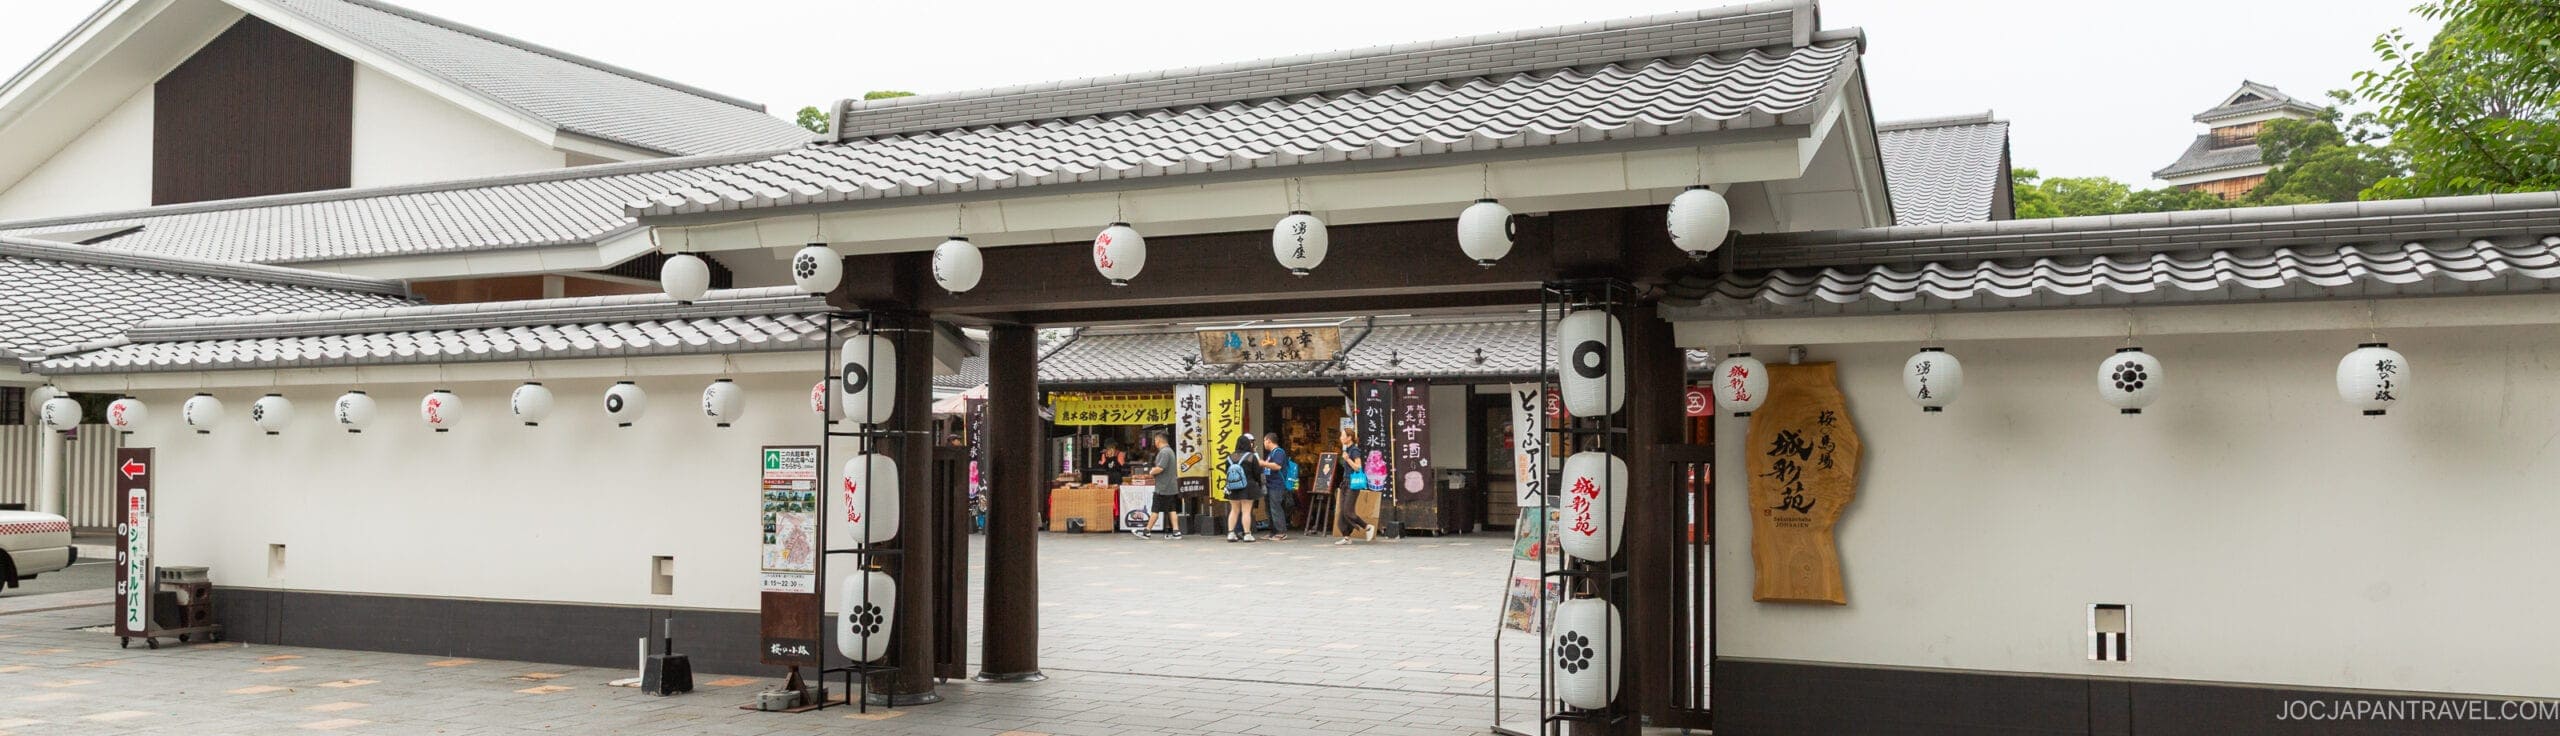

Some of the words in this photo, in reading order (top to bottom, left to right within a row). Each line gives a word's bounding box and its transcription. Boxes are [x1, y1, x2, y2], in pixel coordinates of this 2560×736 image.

[1223, 329, 1313, 350] 海と山の幸
[1724, 364, 1752, 402] 城彩苑
[2374, 358, 2397, 402] 桜の小路
[1180, 393, 1196, 454] 焼ちくわ
[1366, 405, 1381, 447] かき氷
[1402, 424, 1422, 460] 甘酒
[1518, 389, 1542, 500] とうふアイス
[1817, 409, 1838, 471] 桜の馬場
[1759, 429, 1816, 514] 城彩苑
[1565, 476, 1601, 537] 城彩苑
[118, 523, 127, 595] のりば
[770, 643, 810, 656] 桜の小路
